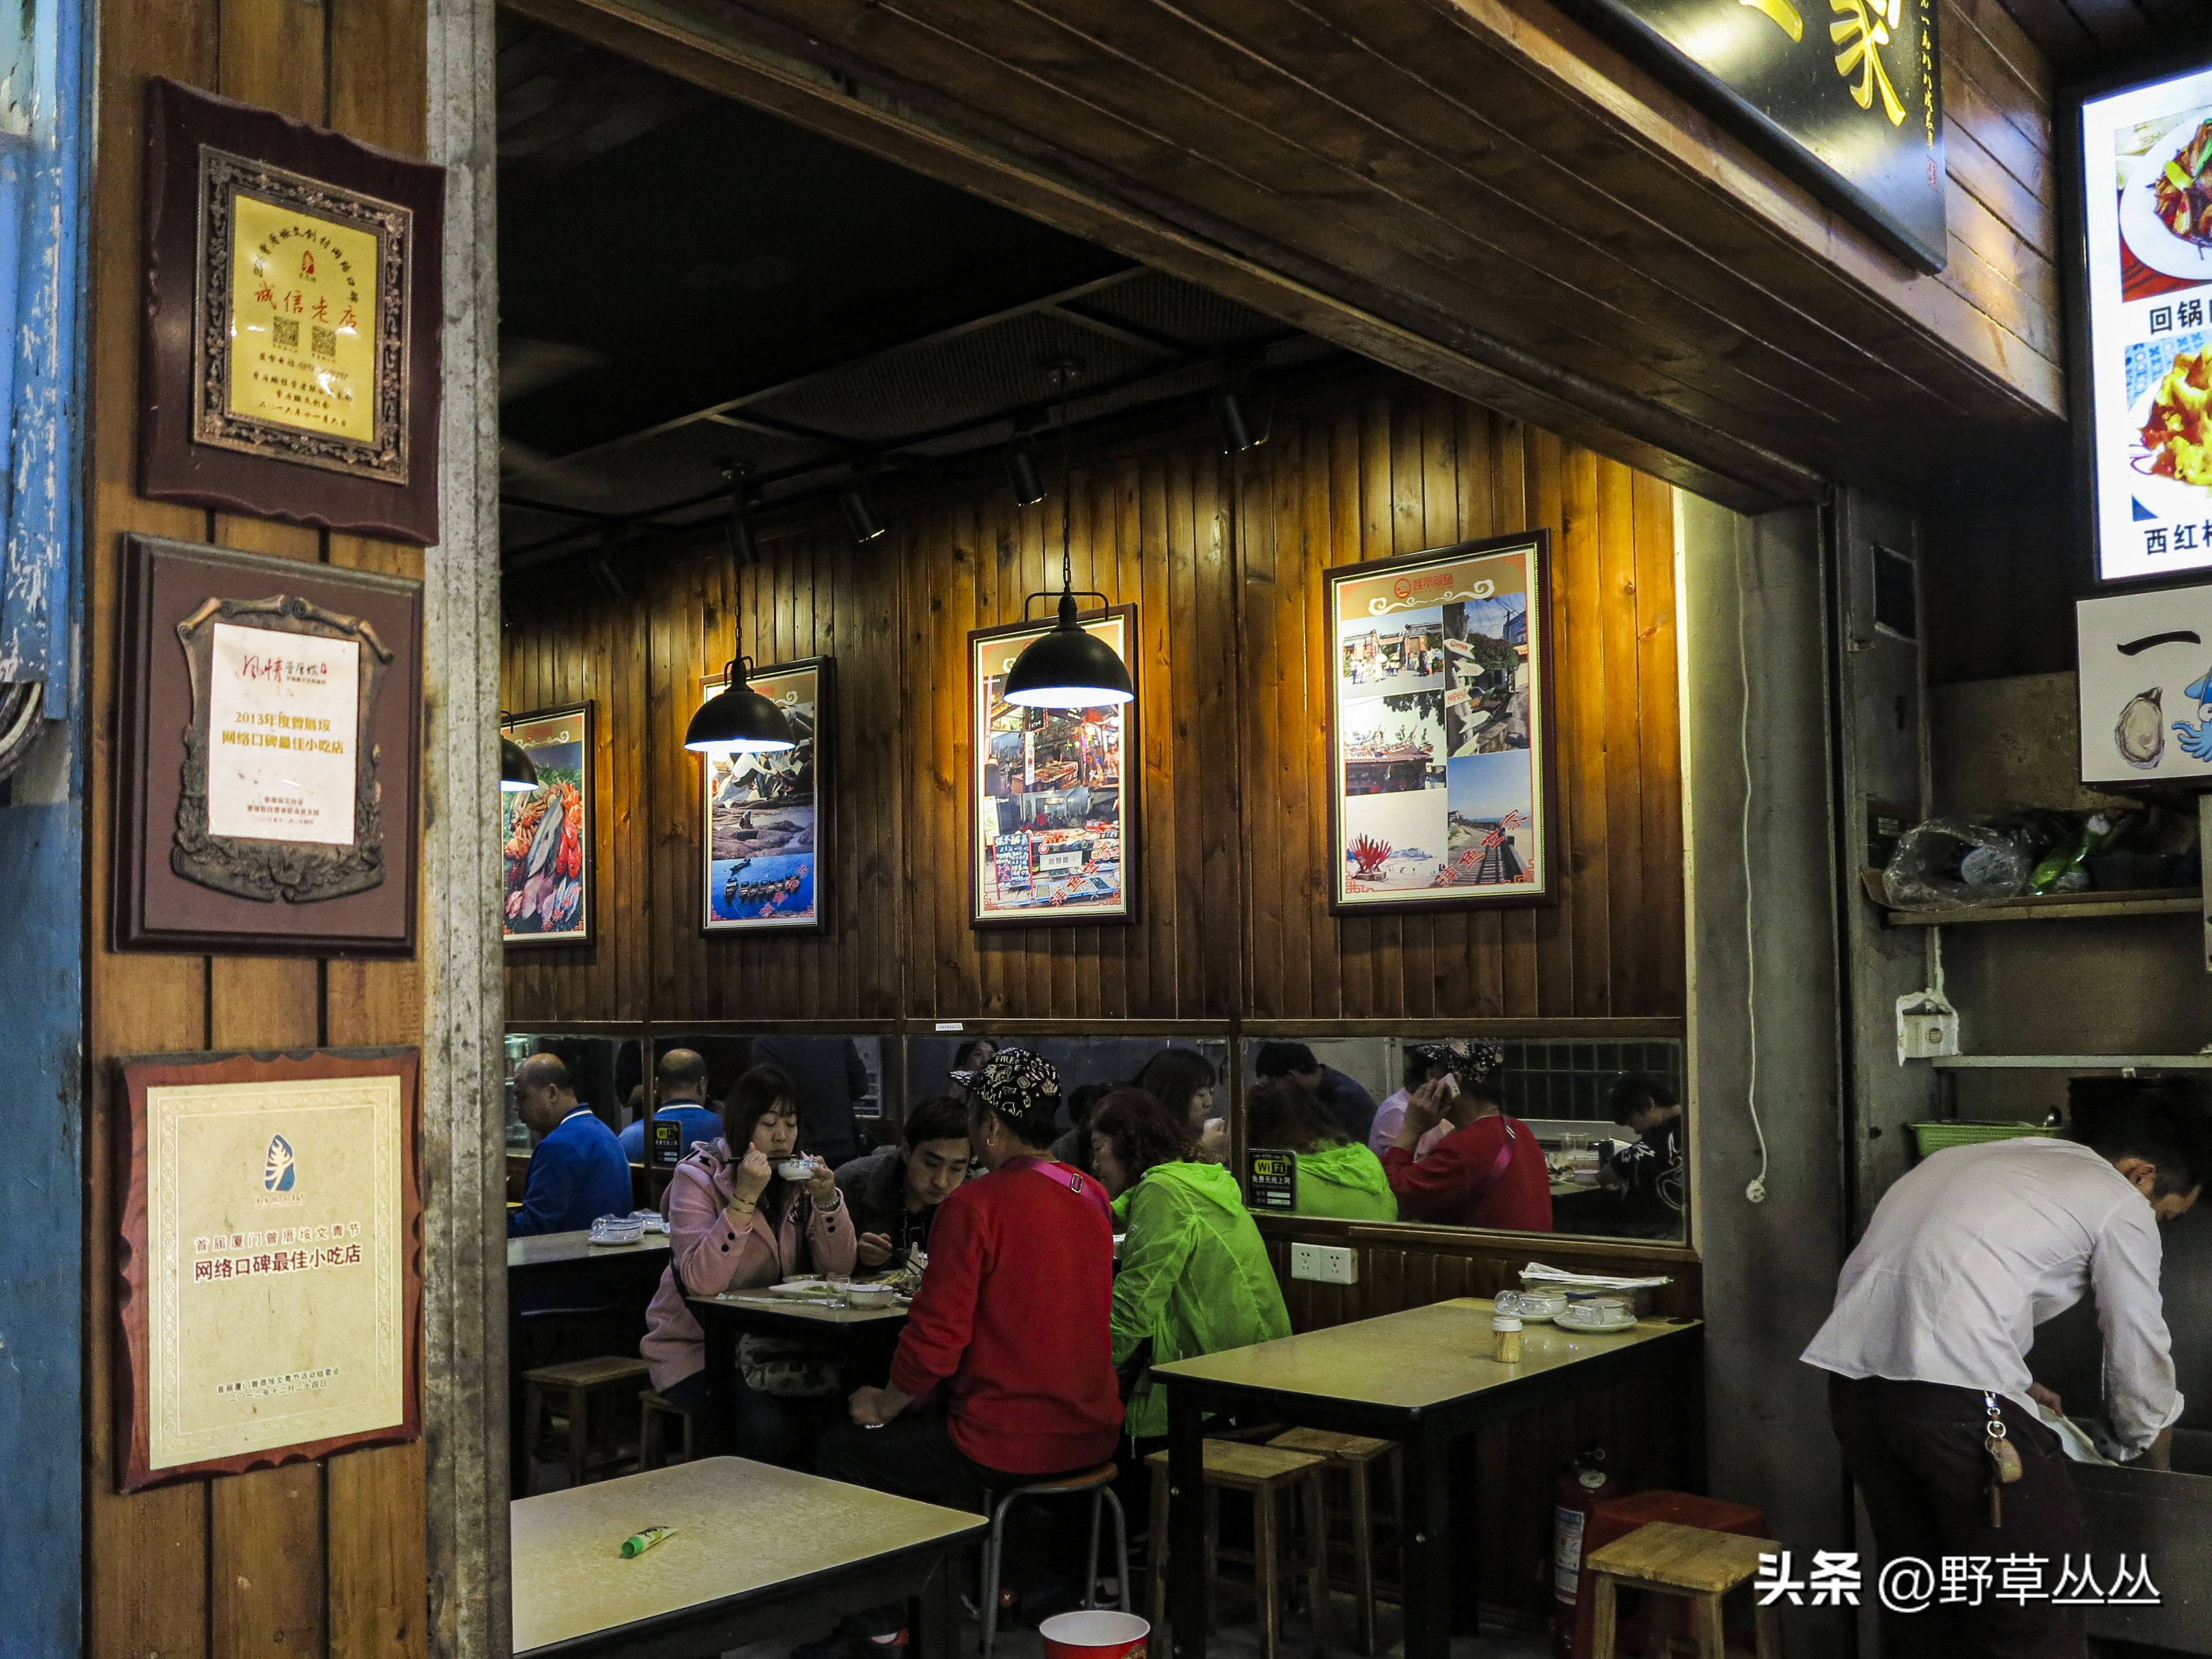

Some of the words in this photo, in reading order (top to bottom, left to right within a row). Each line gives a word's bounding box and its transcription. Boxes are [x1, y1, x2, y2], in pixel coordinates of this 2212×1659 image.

[2149, 299, 2212, 335] 回锅
[222, 730, 344, 754] 网络口碑最佳小吃店
[195, 1244, 361, 1282] 网络口碑最佳小吃店
